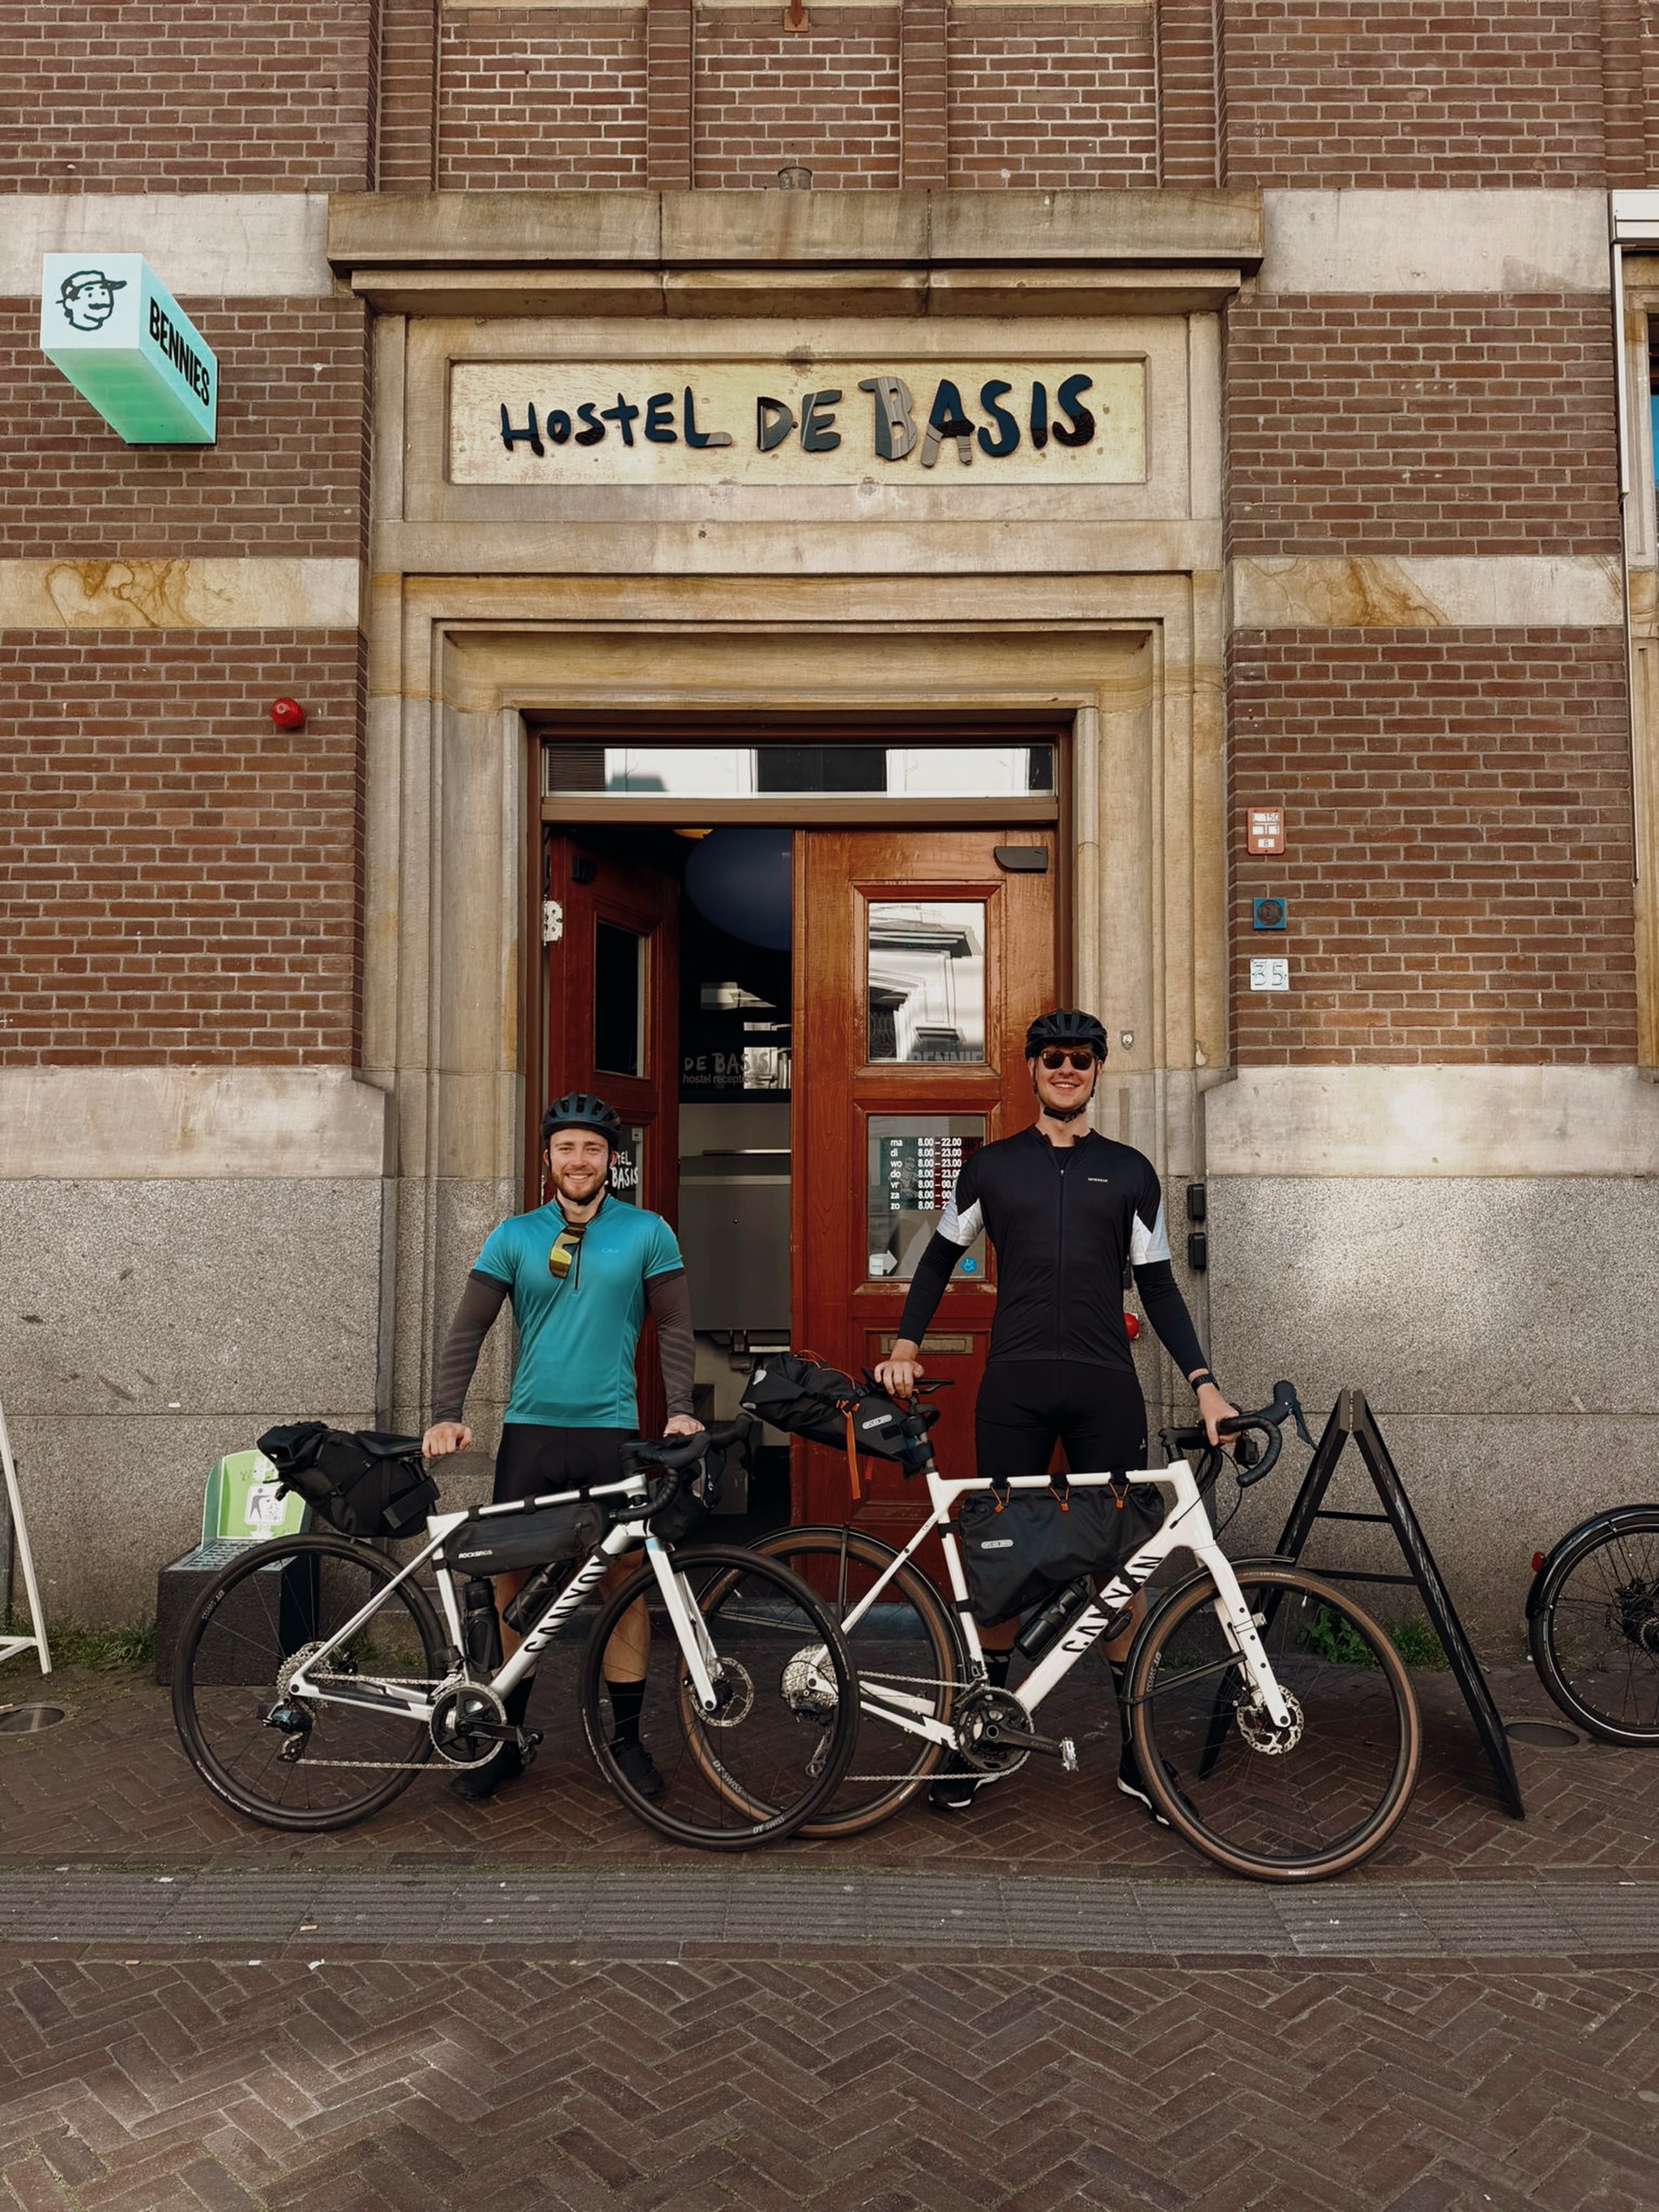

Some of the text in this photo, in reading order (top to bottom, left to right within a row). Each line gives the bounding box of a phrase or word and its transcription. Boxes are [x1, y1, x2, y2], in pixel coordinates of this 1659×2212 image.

[149, 296, 210, 407] BENNIES
[757, 389, 843, 452] DE
[857, 373, 1095, 467] BASIS
[1252, 961, 1285, 987] 35
[684, 1052, 770, 1074] DE BASIS
[683, 1073, 711, 1084] hostel
[918, 1138, 934, 1147] 8.00
[941, 1138, 962, 1147] 22.00
[890, 1149, 898, 1157] di
[918, 1149, 934, 1157] 8.00
[941, 1149, 962, 1157] 23.00
[918, 1159, 934, 1167] 8.00
[941, 1159, 962, 1167] 23.00
[612, 1166, 638, 1189] BASIS
[890, 1170, 901, 1178] do
[918, 1170, 934, 1178] 8.00
[918, 1180, 934, 1188] 8.00
[918, 1191, 934, 1199] 8.00
[918, 1201, 934, 1209] 8.00
